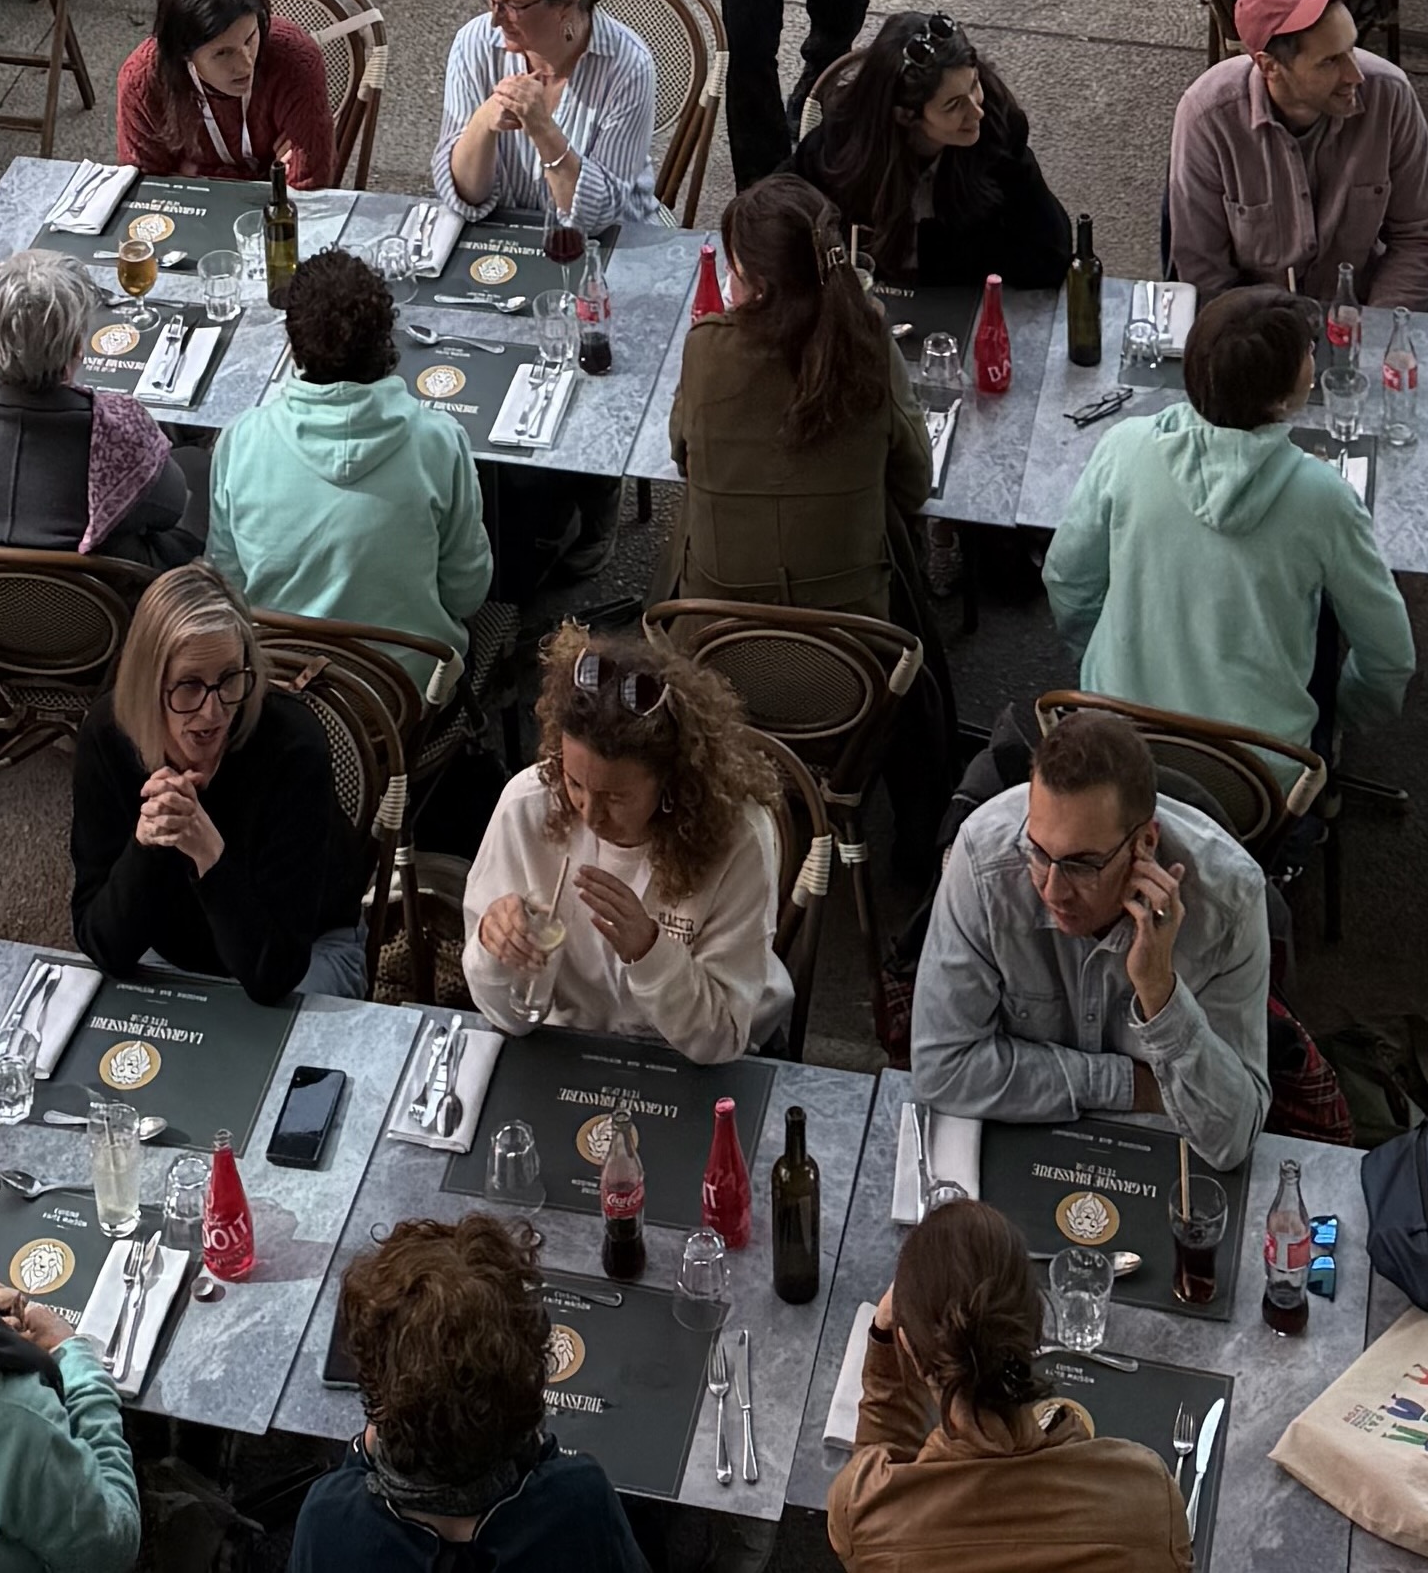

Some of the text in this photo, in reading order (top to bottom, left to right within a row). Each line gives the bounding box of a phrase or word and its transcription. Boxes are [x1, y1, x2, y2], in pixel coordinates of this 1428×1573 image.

[144, 1024, 189, 1042] GRANDE
[190, 1031, 204, 1045] LA
[557, 1087, 616, 1108] BRASSERIE
[664, 1105, 678, 1118] LA
[1032, 1163, 1157, 1198] LA GRANDE BRASSERIE
[543, 1389, 605, 1413] BRASSERIE
